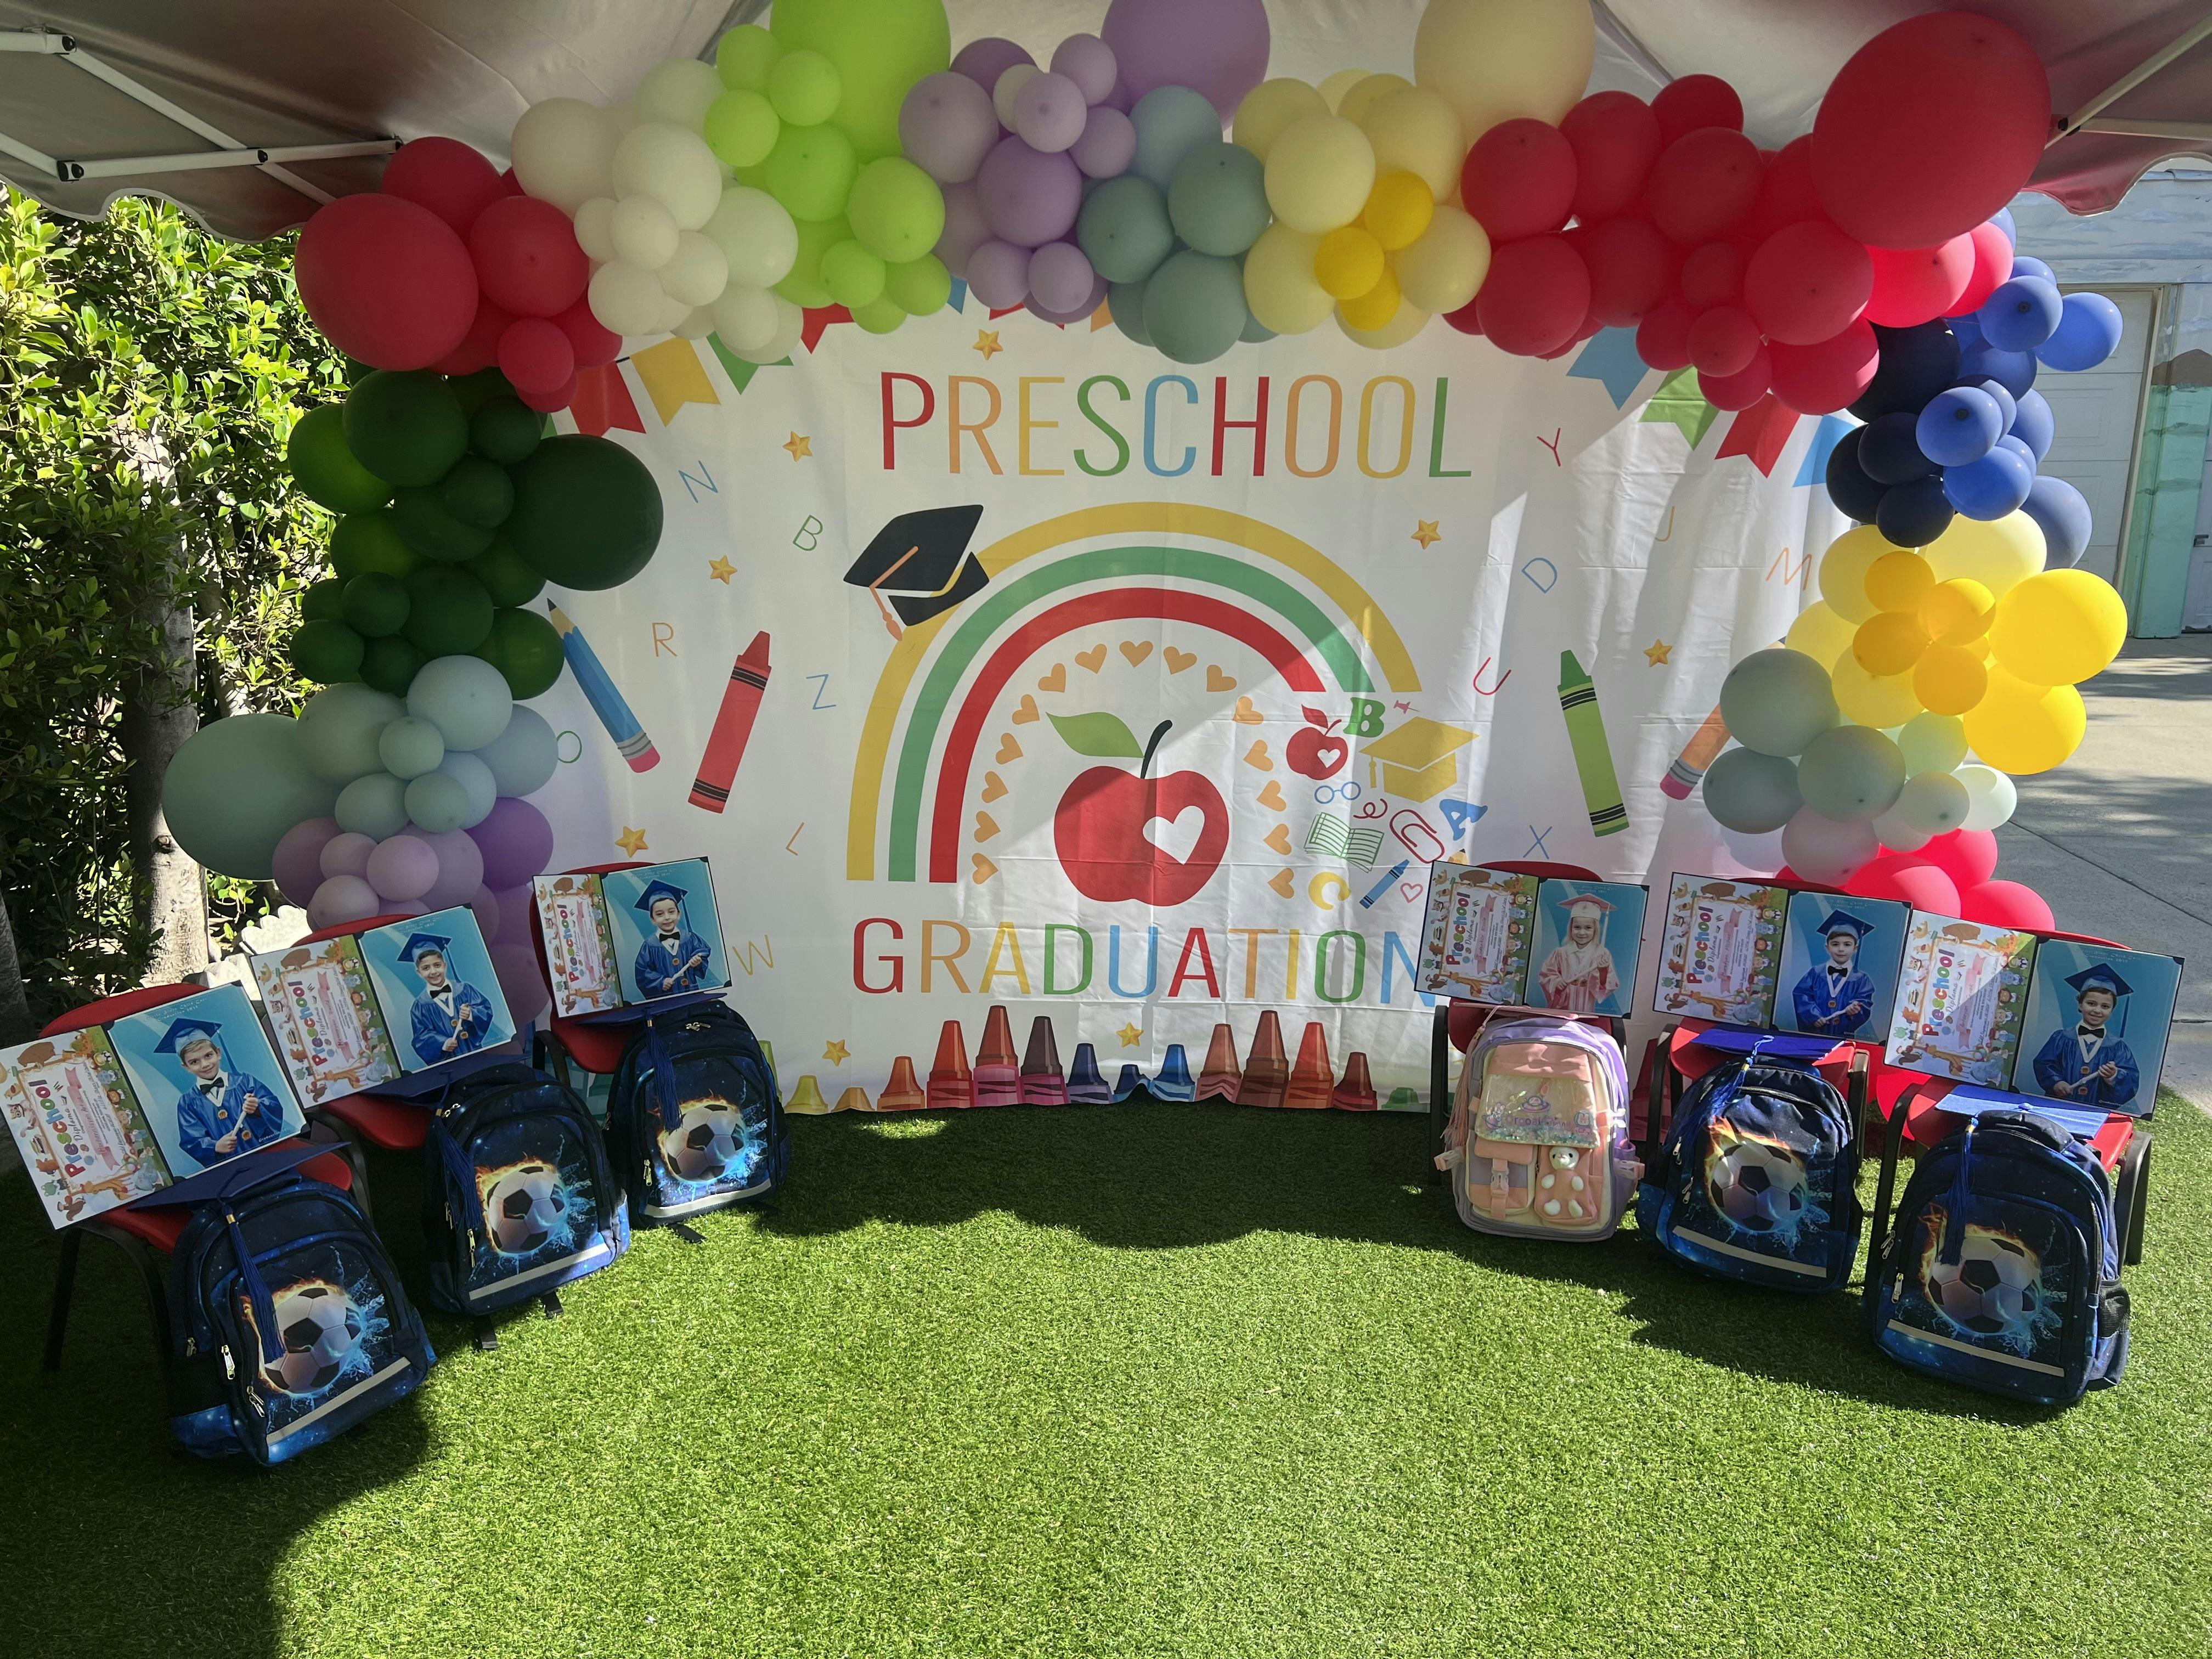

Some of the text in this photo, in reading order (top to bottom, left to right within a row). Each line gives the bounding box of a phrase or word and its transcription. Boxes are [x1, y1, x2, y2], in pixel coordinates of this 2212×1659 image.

[881, 371, 1472, 478] PRESCHOOL
[1537, 427, 1561, 466] Y
[678, 460, 719, 503] N
[792, 515, 823, 551] B
[1521, 557, 1558, 593] D
[1765, 547, 1812, 591] M
[651, 622, 677, 657] R
[806, 674, 837, 710] Z
[1473, 657, 1511, 695] U
[1343, 697, 1386, 737] B
[556, 730, 582, 763] O
[1439, 799, 1488, 840] A
[1523, 825, 1552, 859] X
[556, 904, 579, 982] Preschool
[1444, 891, 1470, 965] Preschool
[1465, 919, 1475, 945] Diploma
[1685, 906, 1713, 984] Preschool
[732, 934, 774, 975] W
[853, 918, 1436, 1007] GRADUATION
[1707, 934, 1718, 963] Diploma
[1921, 948, 1955, 1036] Preschool
[1945, 981, 1958, 1013] Diploma
[287, 980, 328, 1067] Preschool
[313, 1006, 328, 1037] Diploma
[27, 1079, 86, 1178] Preschool
[64, 1107, 83, 1142] Diploma
